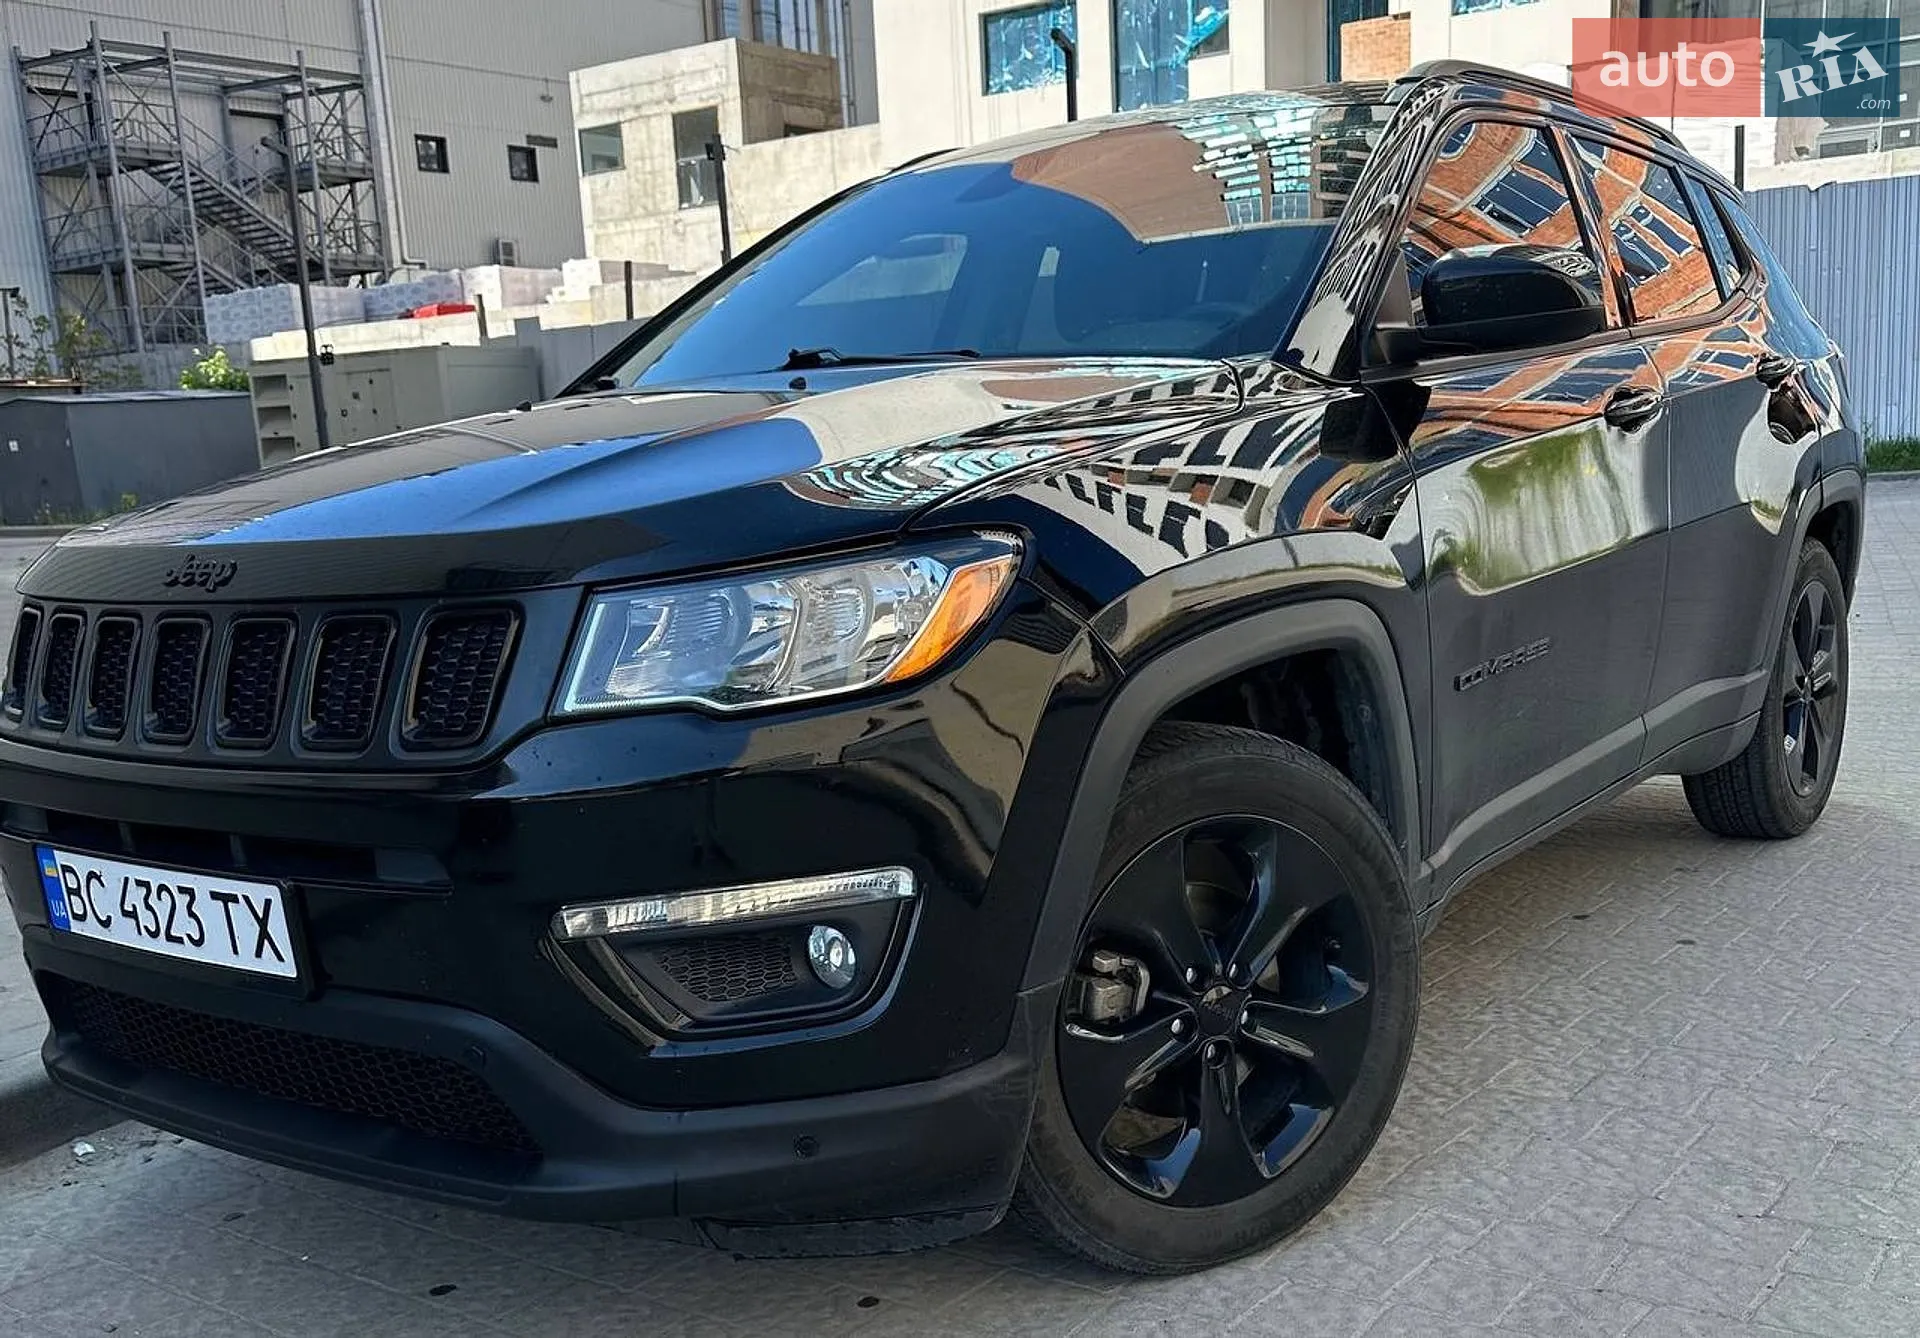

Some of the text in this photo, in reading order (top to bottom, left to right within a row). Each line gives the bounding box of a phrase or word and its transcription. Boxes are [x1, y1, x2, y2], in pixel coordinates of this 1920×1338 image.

[163, 552, 238, 594] Jeep
[50, 899, 68, 919] UA
[60, 863, 286, 963] BC 4323 TX
